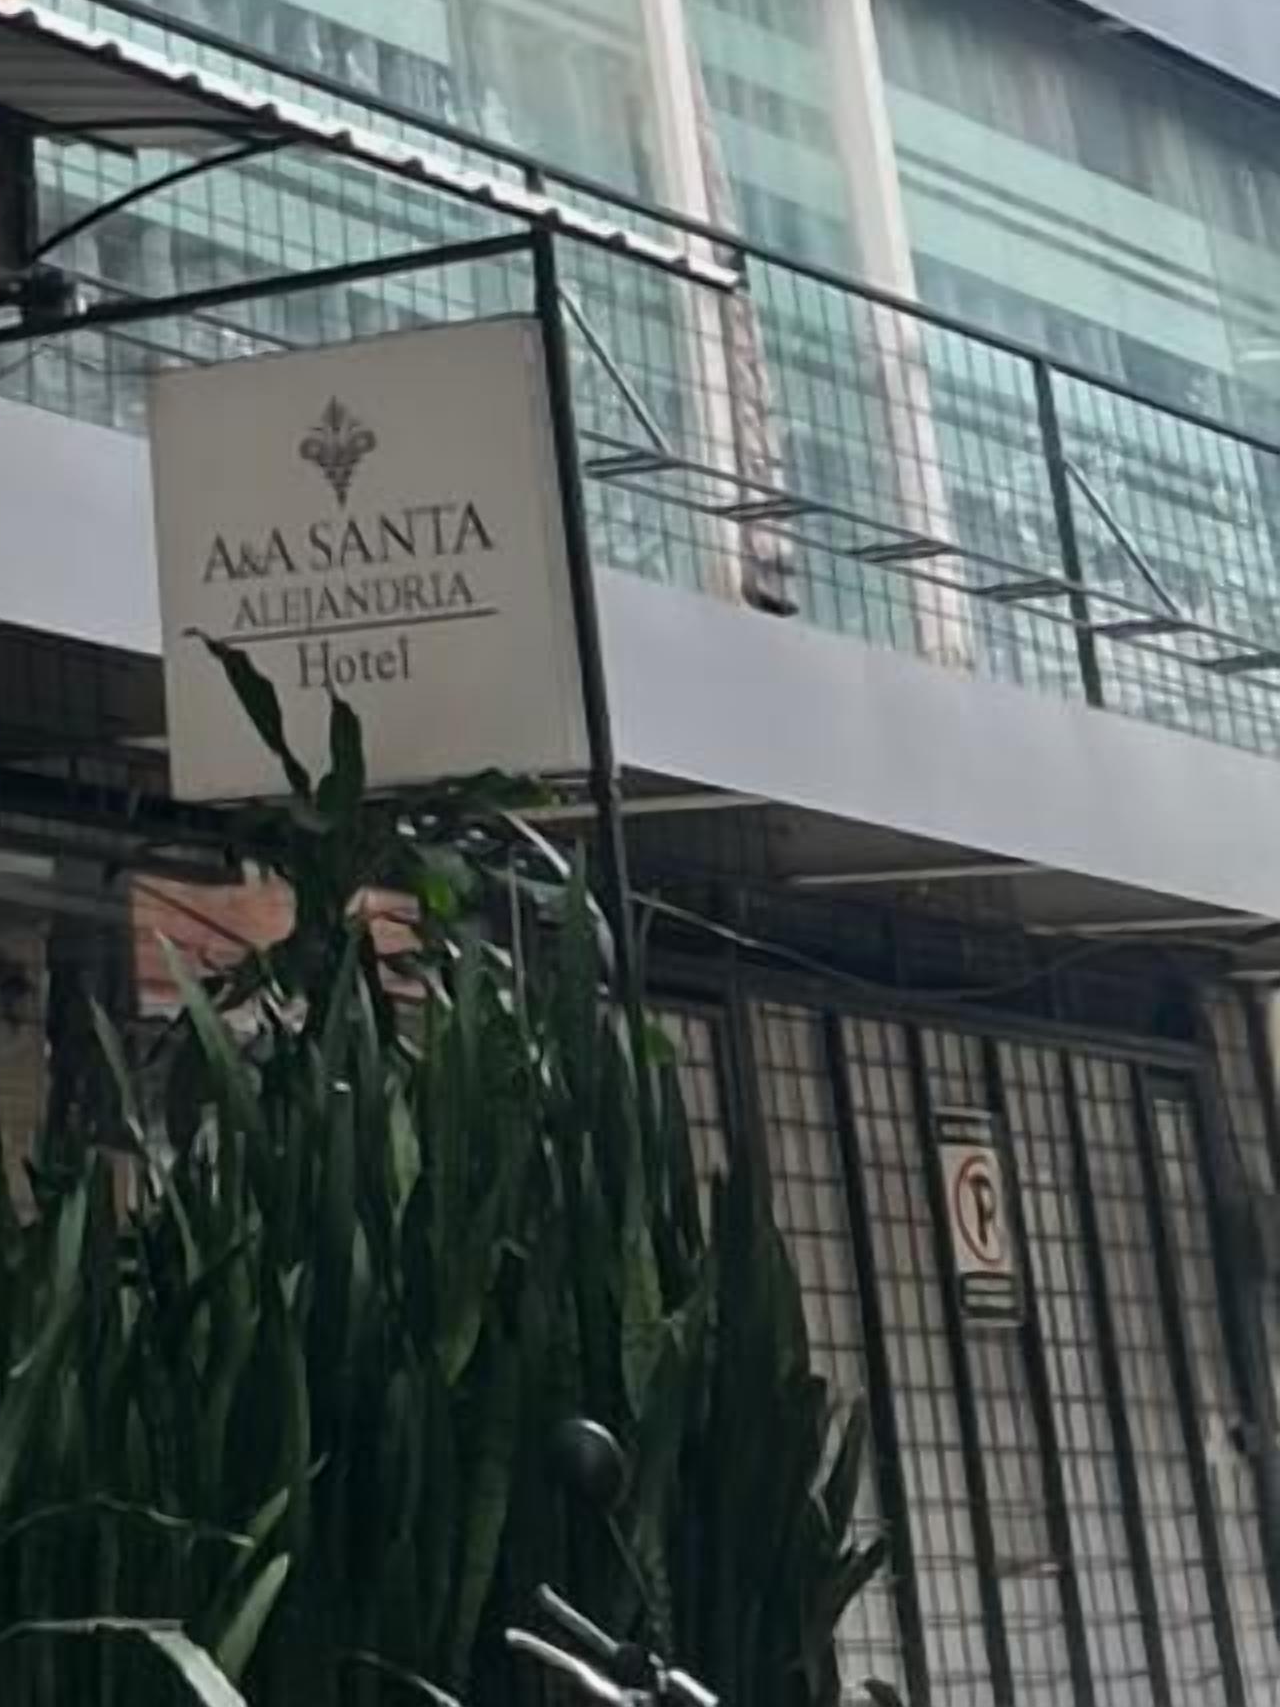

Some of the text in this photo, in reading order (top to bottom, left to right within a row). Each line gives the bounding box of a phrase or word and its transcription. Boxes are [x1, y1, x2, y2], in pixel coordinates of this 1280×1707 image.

[308, 501, 493, 572] SANTA
[233, 571, 474, 631] ALEJANDRIA
[297, 635, 410, 688] Hotel
